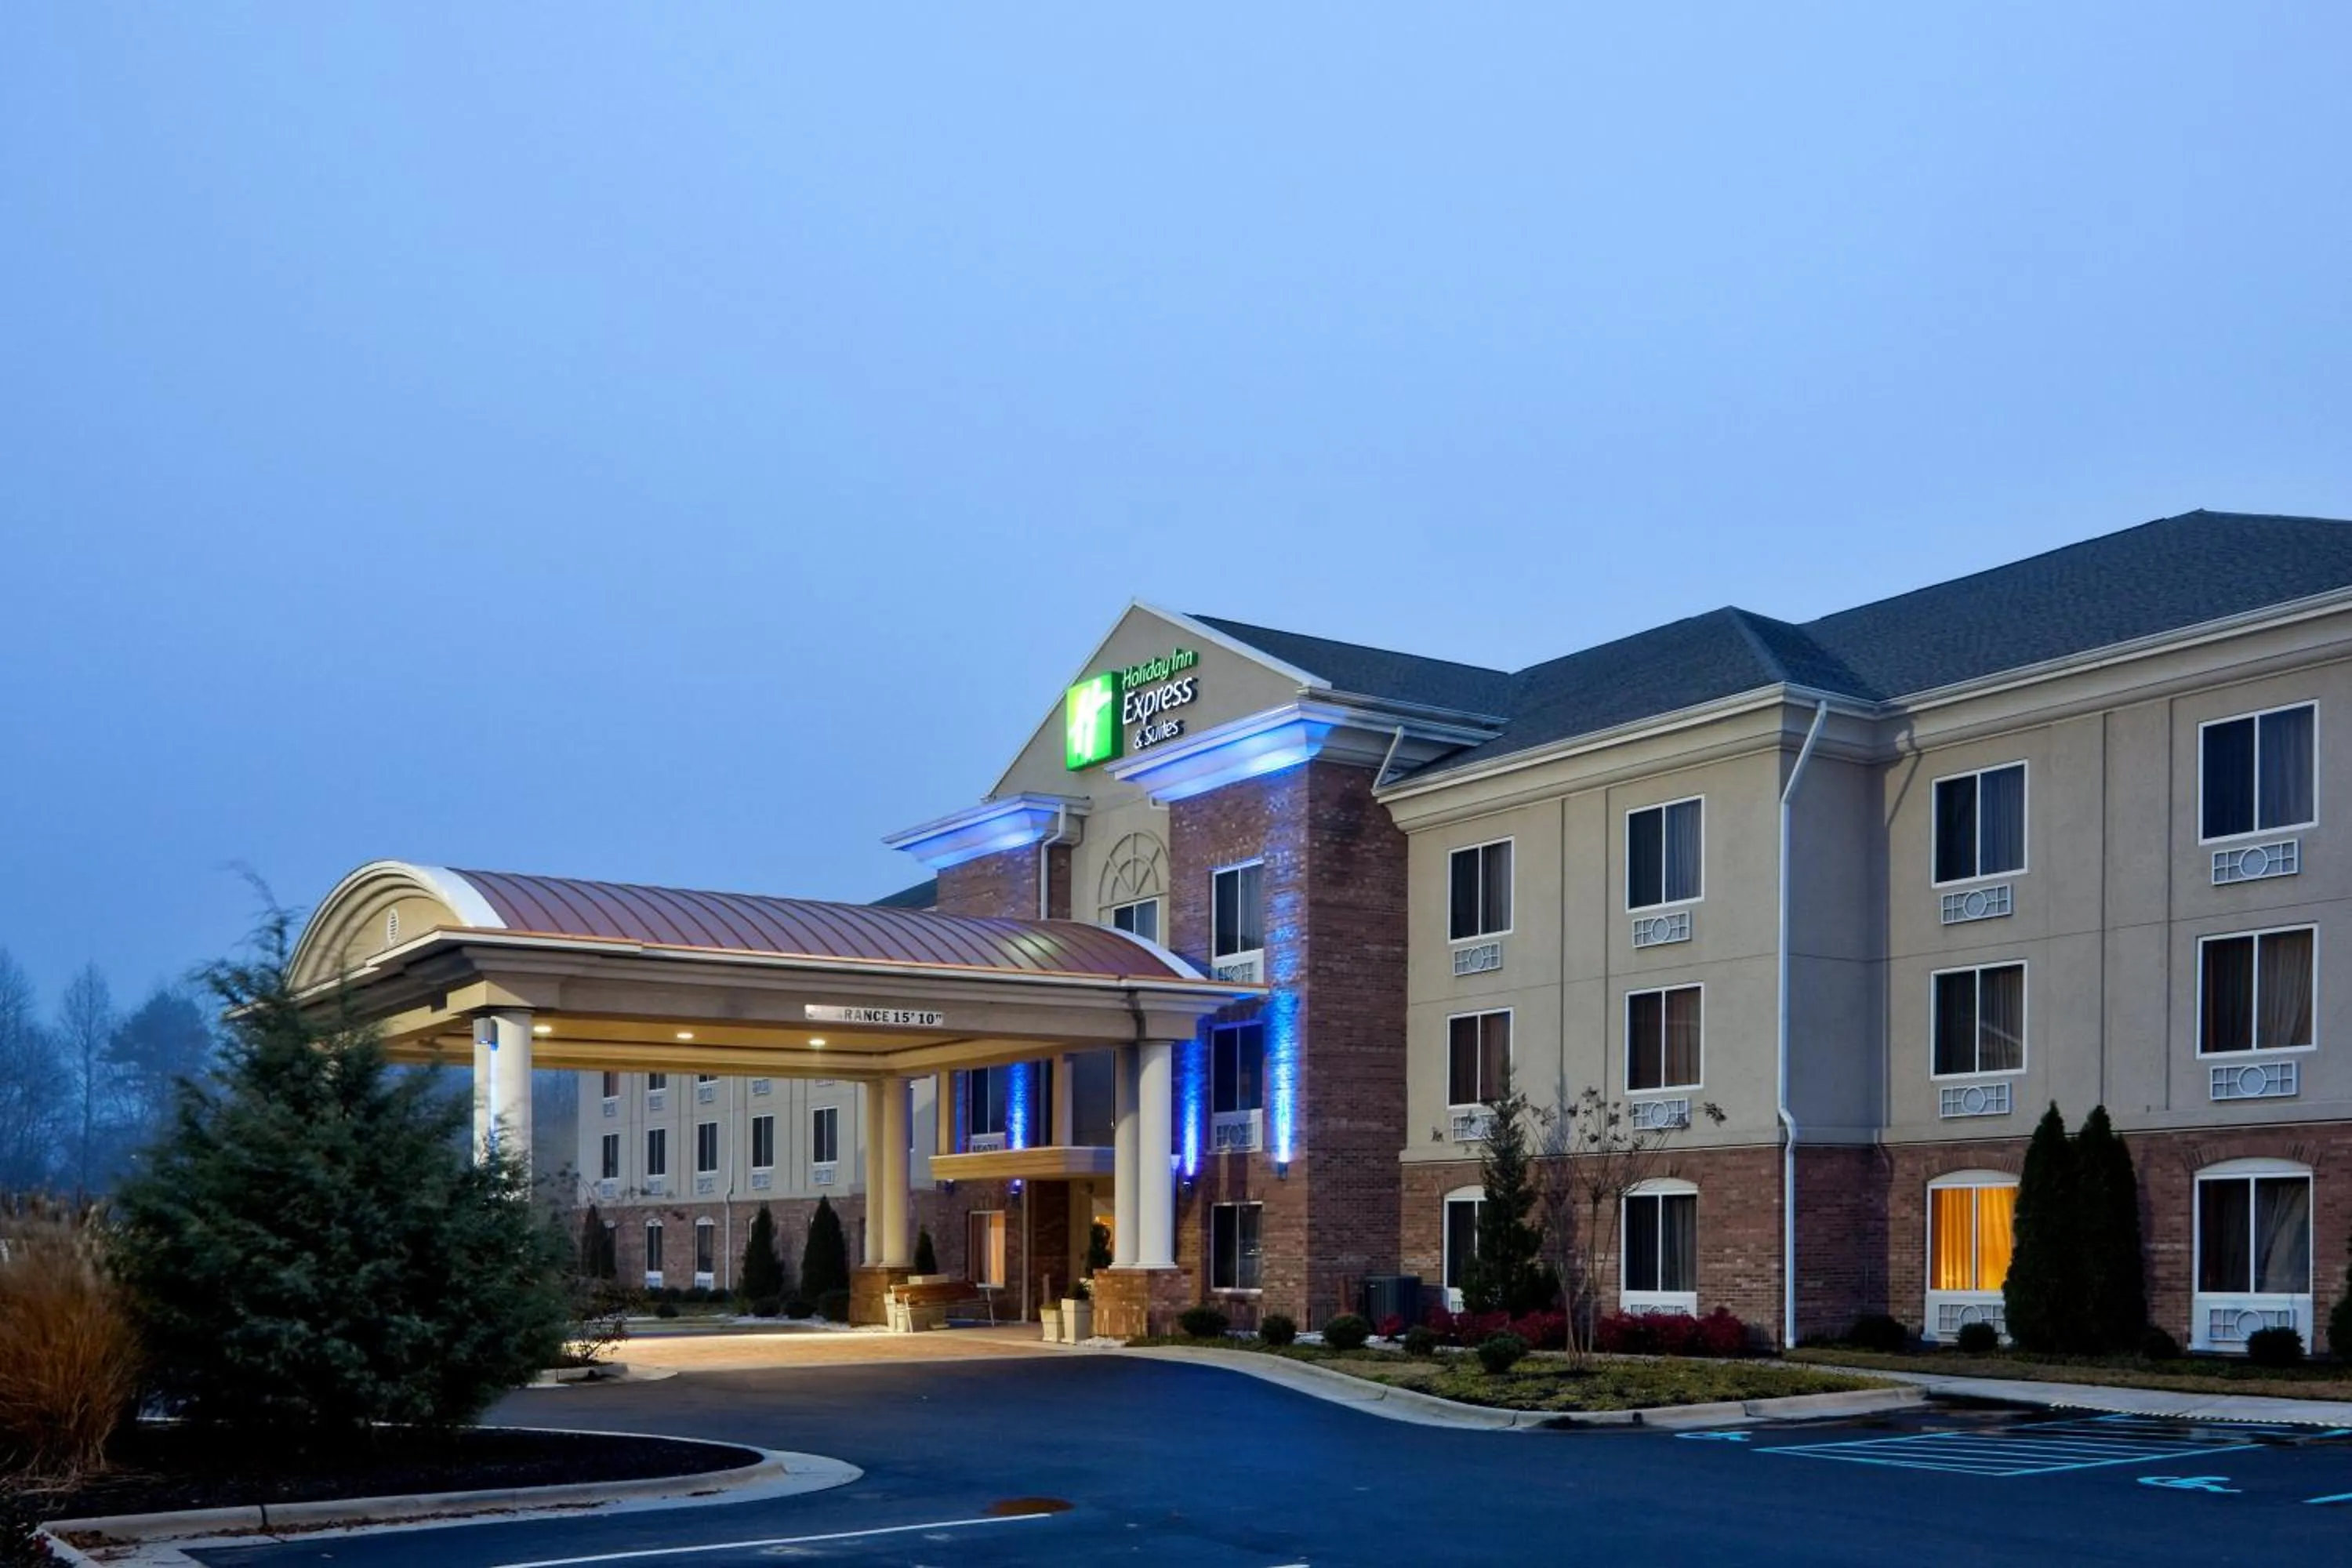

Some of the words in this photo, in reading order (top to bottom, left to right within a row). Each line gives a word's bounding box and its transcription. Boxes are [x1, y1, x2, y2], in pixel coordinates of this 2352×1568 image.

[1123, 657, 1170, 689] Holiday
[1172, 648, 1193, 670] Inn
[1123, 677, 1193, 725] Express
[1134, 729, 1144, 750] &
[1145, 719, 1179, 745] Suites
[835, 1007, 890, 1022] RANCE
